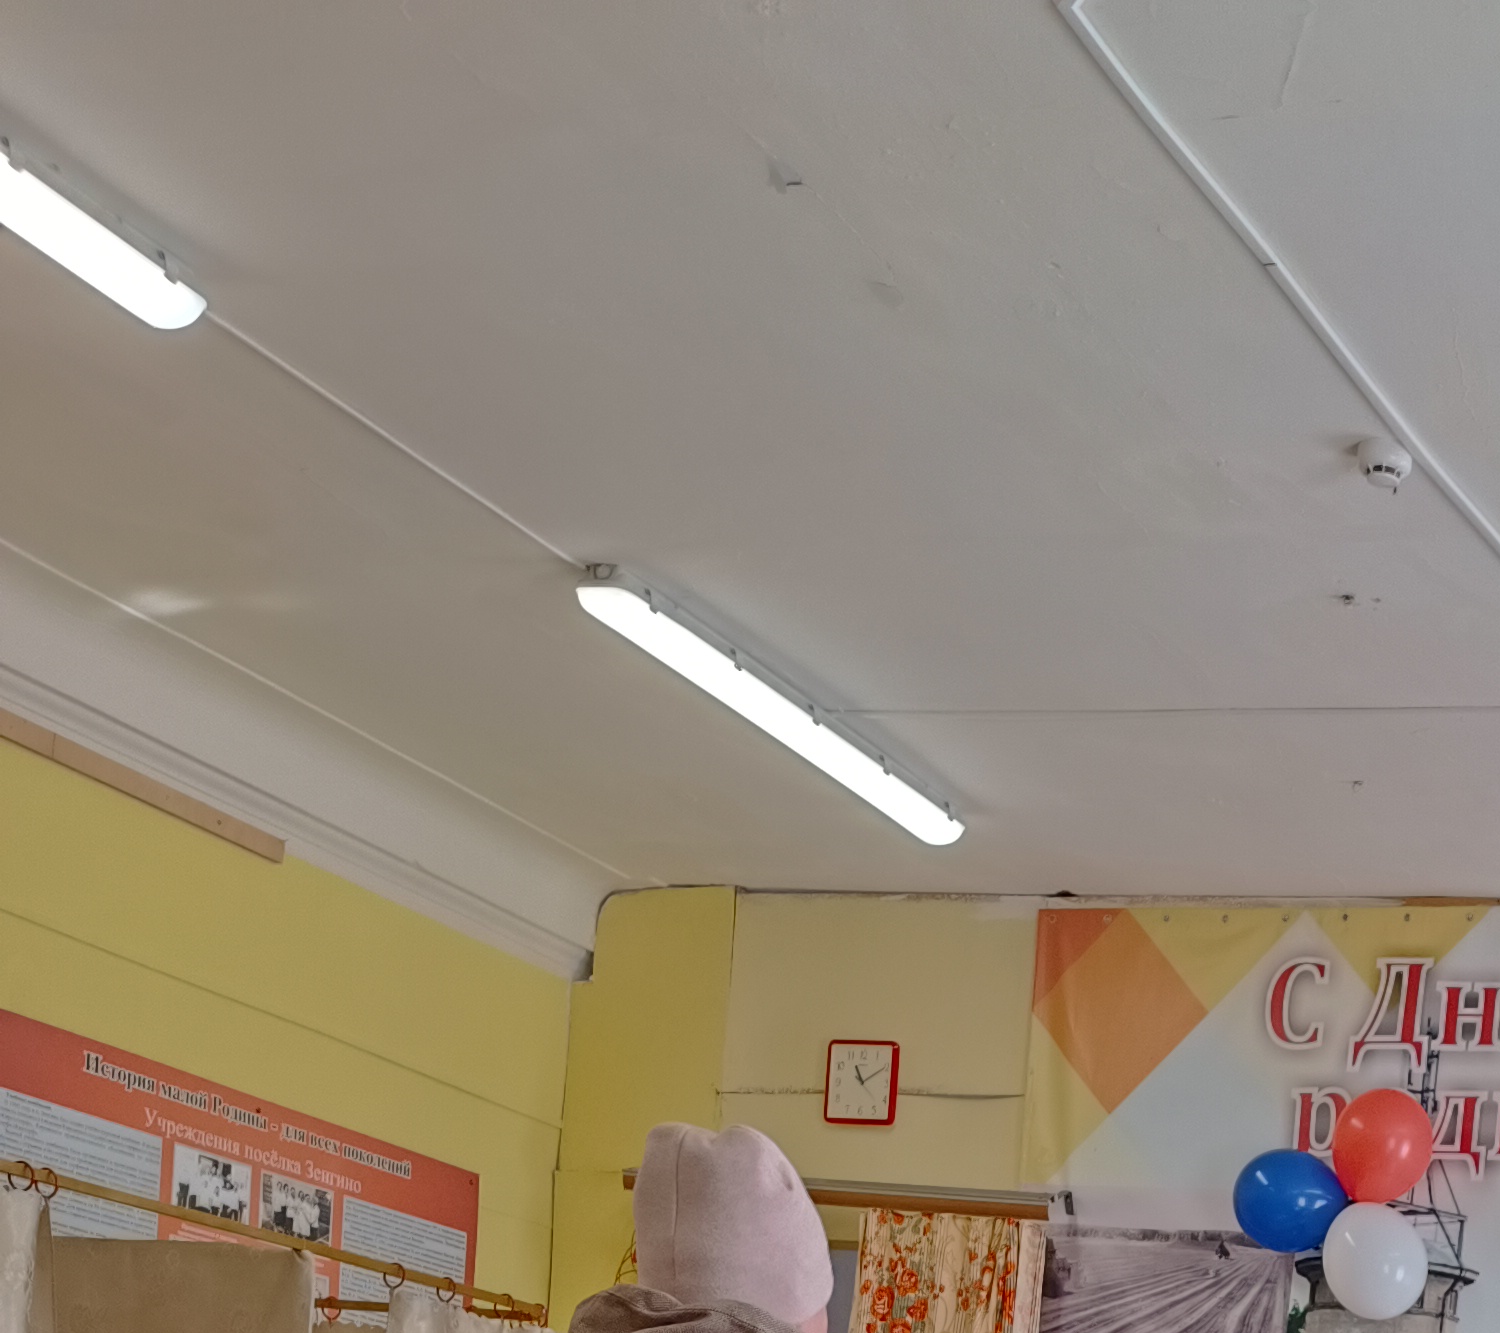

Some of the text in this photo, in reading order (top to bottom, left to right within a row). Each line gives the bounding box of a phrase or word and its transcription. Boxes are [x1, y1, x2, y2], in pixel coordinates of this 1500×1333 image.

[1266, 957, 1331, 1050] С
[83, 1050, 157, 1093] История
[158, 1080, 209, 1113] малой
[210, 1093, 269, 1132] Родины
[280, 1123, 308, 1146] для
[308, 1132, 341, 1157] всех
[342, 1142, 412, 1179] поколений
[144, 1107, 241, 1157] Учреждения
[244, 1143, 301, 1176] посёлка
